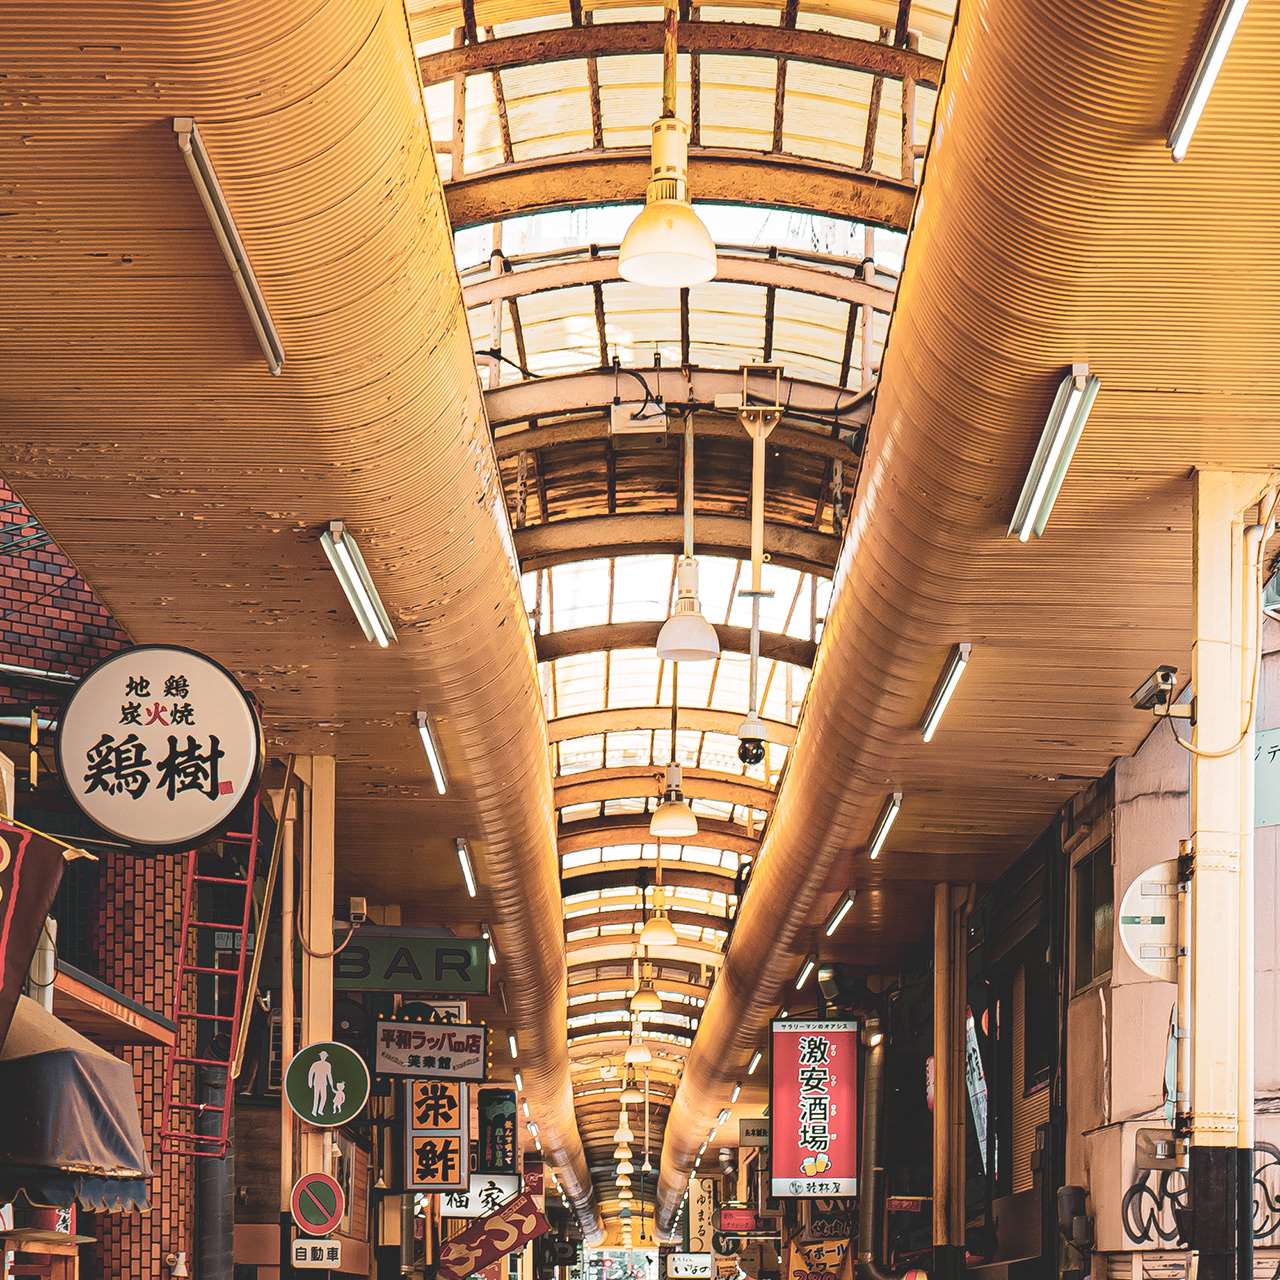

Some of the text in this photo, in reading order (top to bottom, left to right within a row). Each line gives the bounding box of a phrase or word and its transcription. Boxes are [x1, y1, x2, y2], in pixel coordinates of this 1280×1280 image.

[118, 701, 197, 727] 炭火焼
[84, 733, 227, 803] 鶏樹
[334, 946, 472, 984] BAR
[798, 1036, 830, 1152] 激安酒場
[295, 1244, 341, 1263] 自動車
